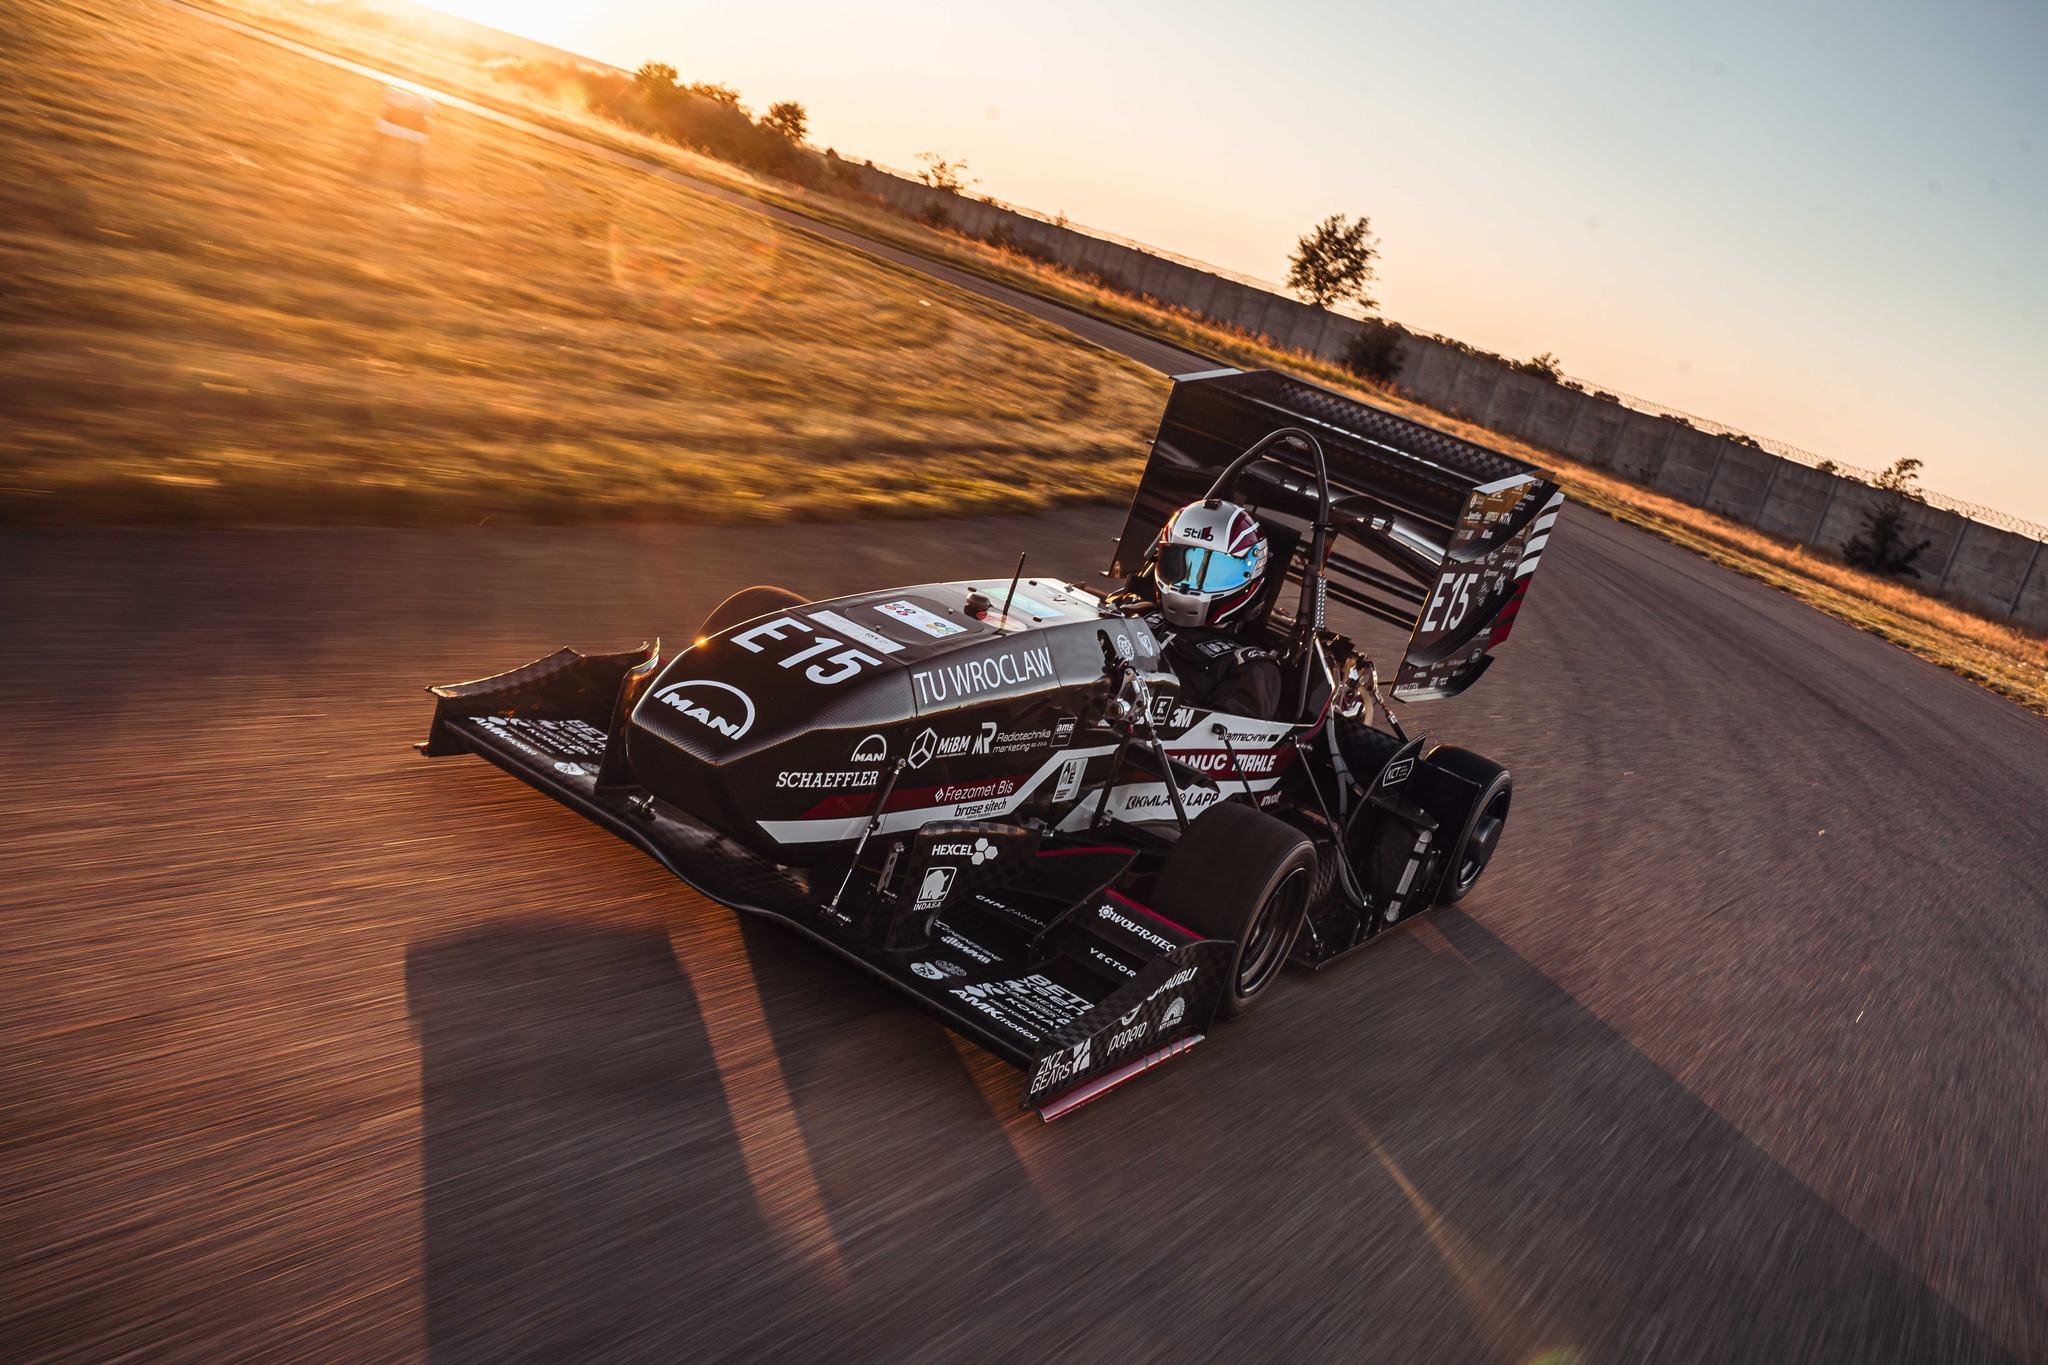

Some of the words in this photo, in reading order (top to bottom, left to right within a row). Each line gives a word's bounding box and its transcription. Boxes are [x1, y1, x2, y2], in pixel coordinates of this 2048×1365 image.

[1421, 573, 1479, 633] E15
[730, 616, 883, 685] E15
[913, 669, 947, 704] TU
[948, 647, 1053, 696] WROCLAW
[661, 692, 740, 737] MAN
[1170, 709, 1195, 728] 3M
[1056, 723, 1074, 732] ams
[937, 735, 971, 755] MiBM
[854, 753, 884, 762] MAN
[1171, 754, 1228, 771] ANUC
[1231, 754, 1277, 772] MAHLE
[776, 771, 878, 788] SCHAEFFLER
[944, 782, 996, 802] Frezamet
[997, 780, 1014, 795] Bis
[1186, 792, 1219, 806] LAPP
[954, 804, 983, 817] brose
[984, 798, 1007, 812] sitech
[932, 844, 973, 856] HEXCEL
[913, 902, 942, 911] INDASA
[1110, 912, 1176, 952] WOLFRATEC
[1090, 947, 1137, 977] VECTOR
[949, 989, 1040, 1042] AMKmotion
[1036, 1050, 1065, 1076] ZKZ
[1030, 1061, 1072, 1095] GEARS
